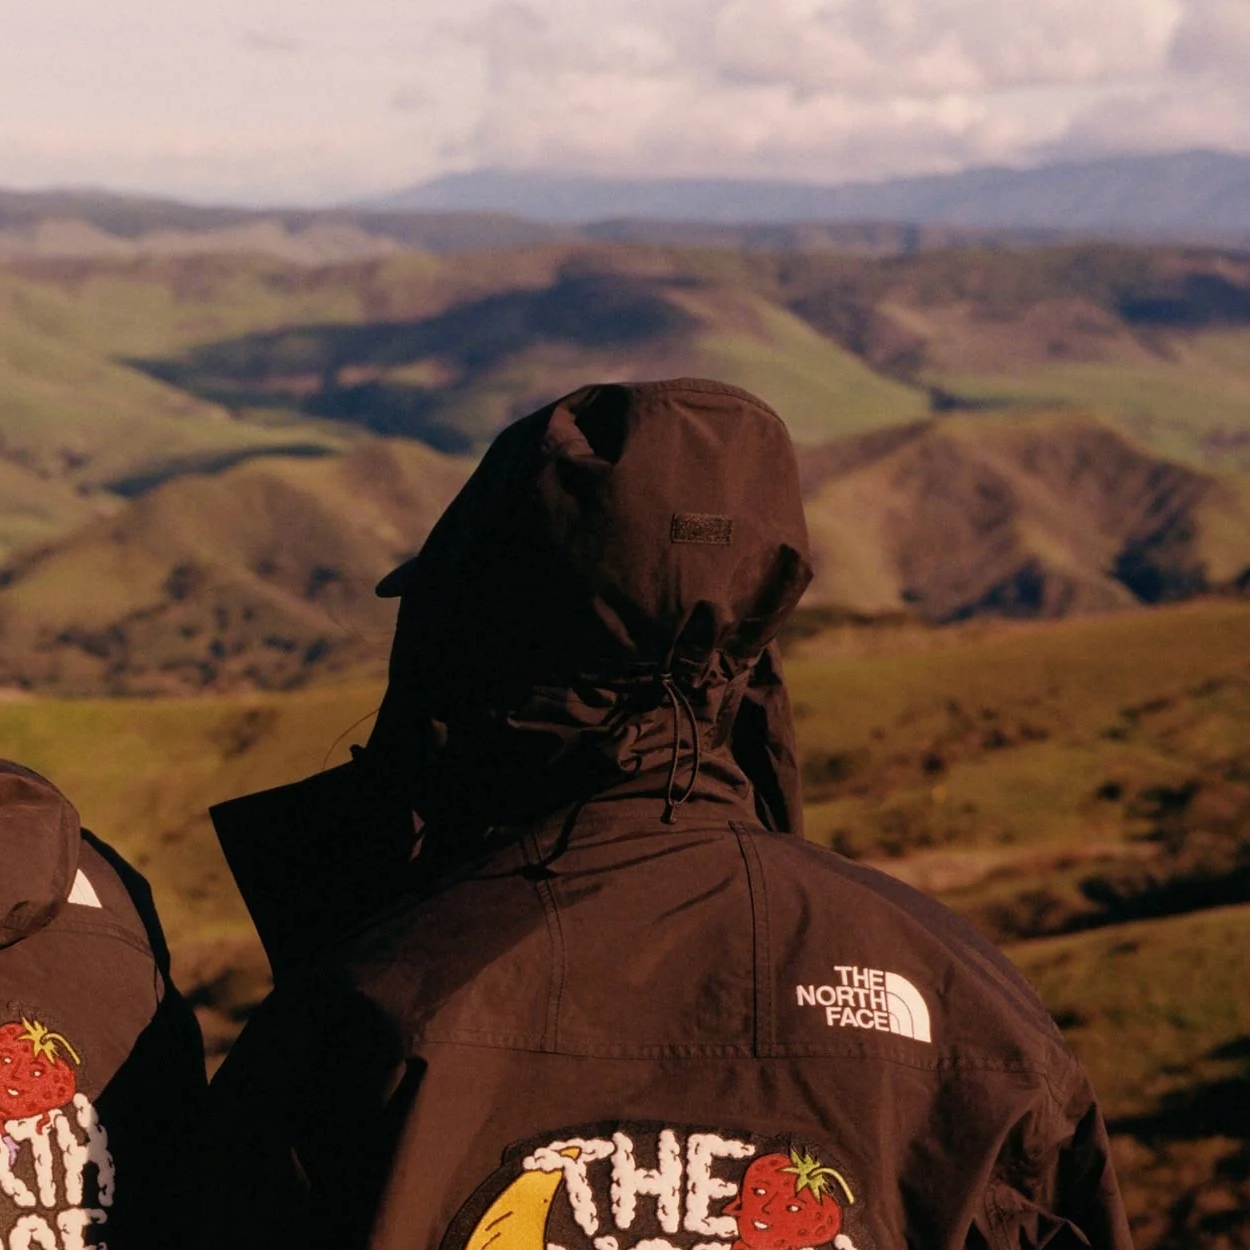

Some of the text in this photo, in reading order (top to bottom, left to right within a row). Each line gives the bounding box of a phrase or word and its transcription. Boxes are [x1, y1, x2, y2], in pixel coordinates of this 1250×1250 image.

[834, 965, 885, 991] THE
[796, 984, 888, 1012] NORTH
[825, 1006, 890, 1032] FACE
[522, 1128, 756, 1237] THE
